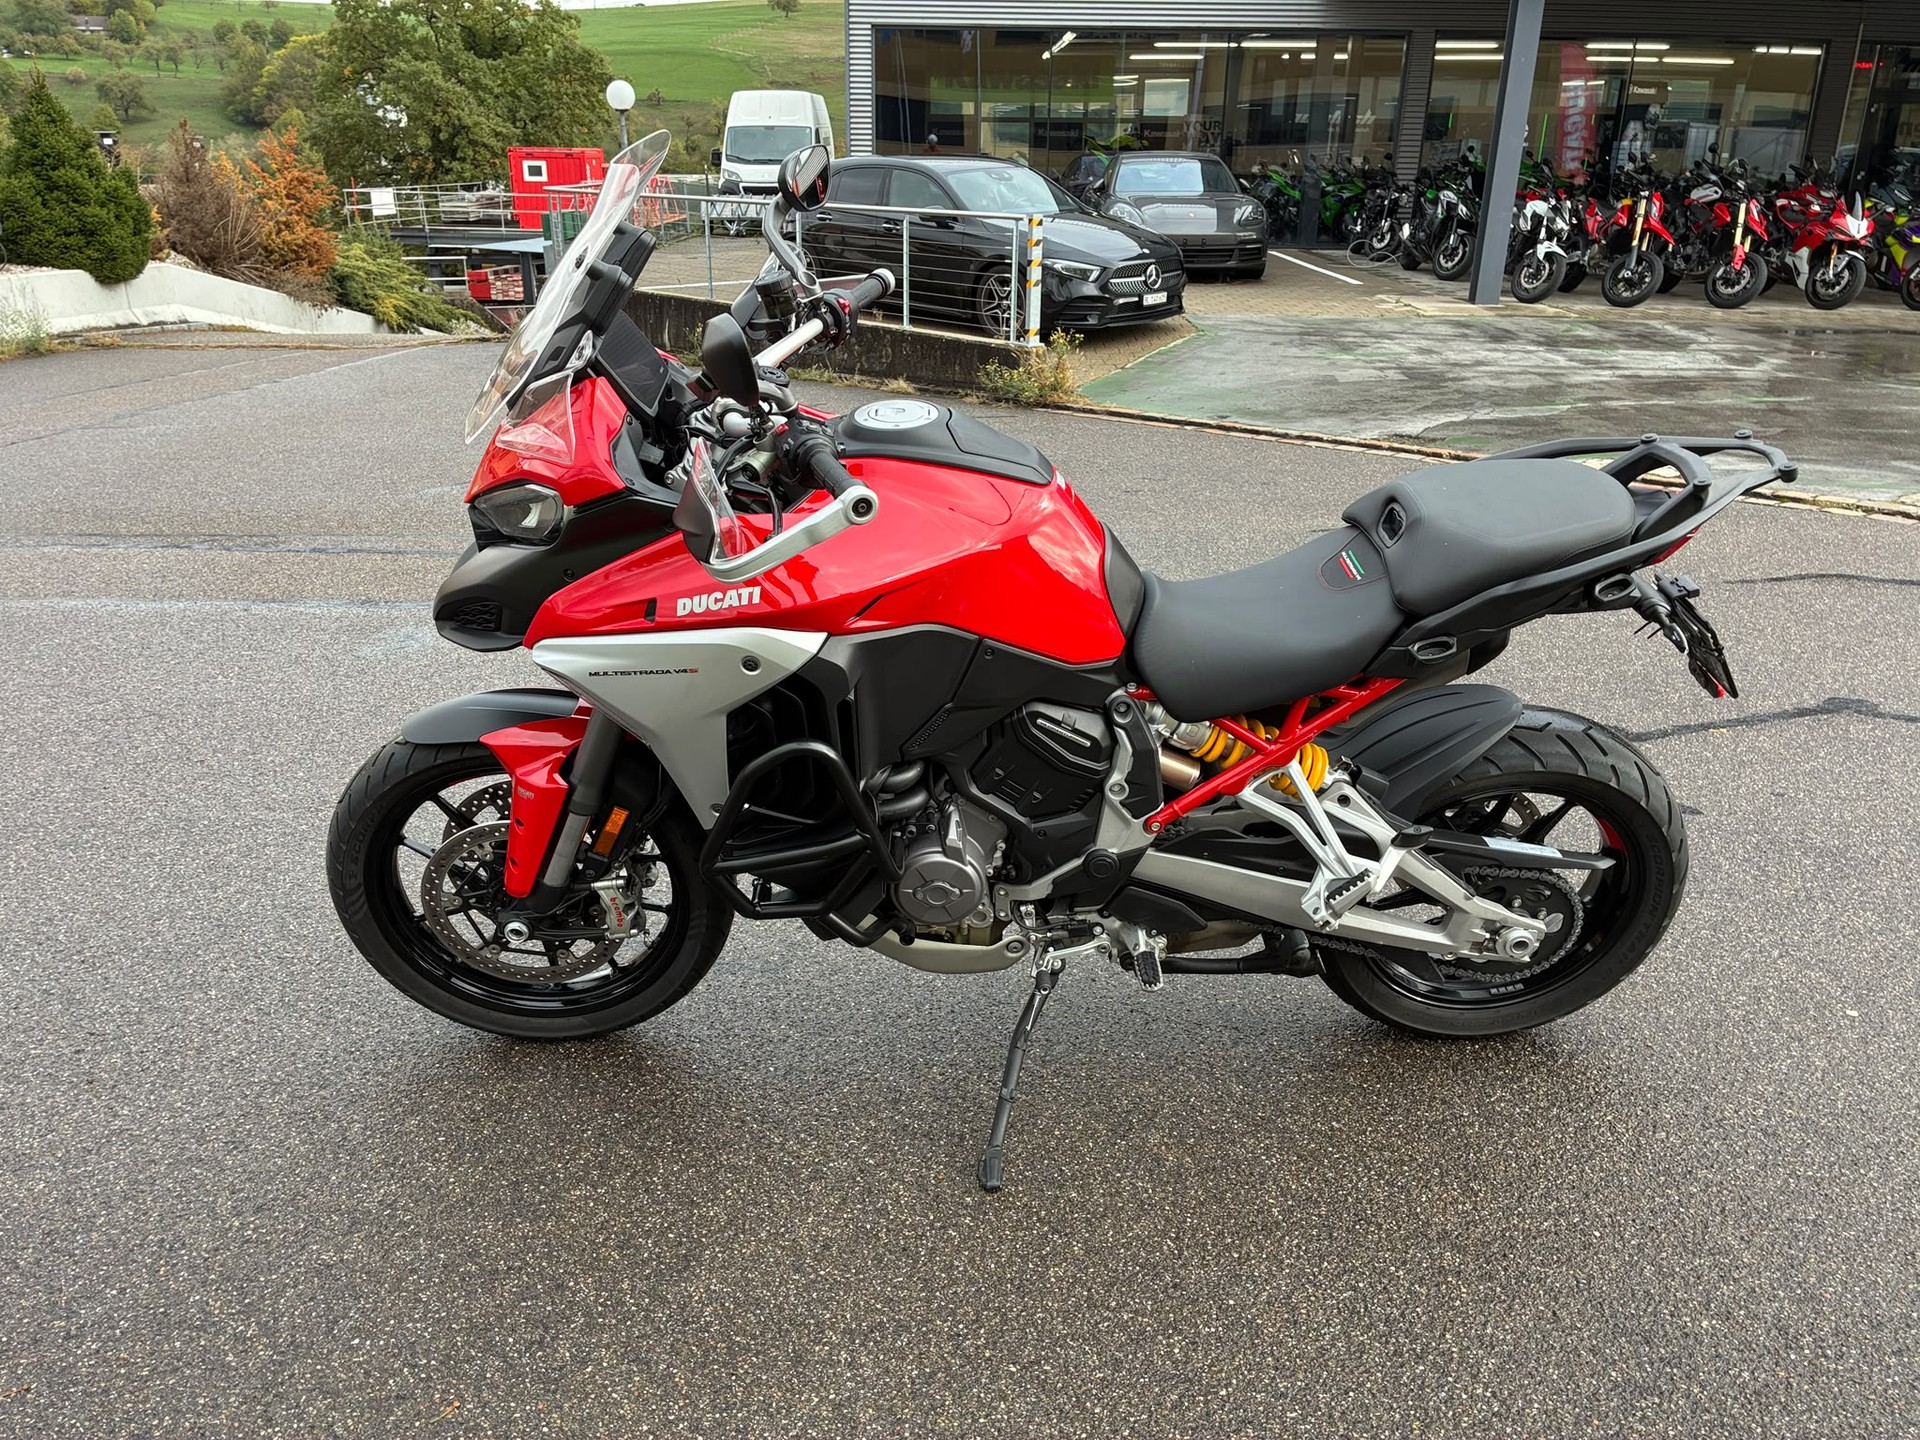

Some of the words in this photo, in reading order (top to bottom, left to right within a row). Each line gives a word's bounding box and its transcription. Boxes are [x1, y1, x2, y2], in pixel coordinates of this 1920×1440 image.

[676, 586, 762, 617] DUCATI
[588, 669, 673, 678] MULTISTRADA
[610, 896, 625, 928] brembo
